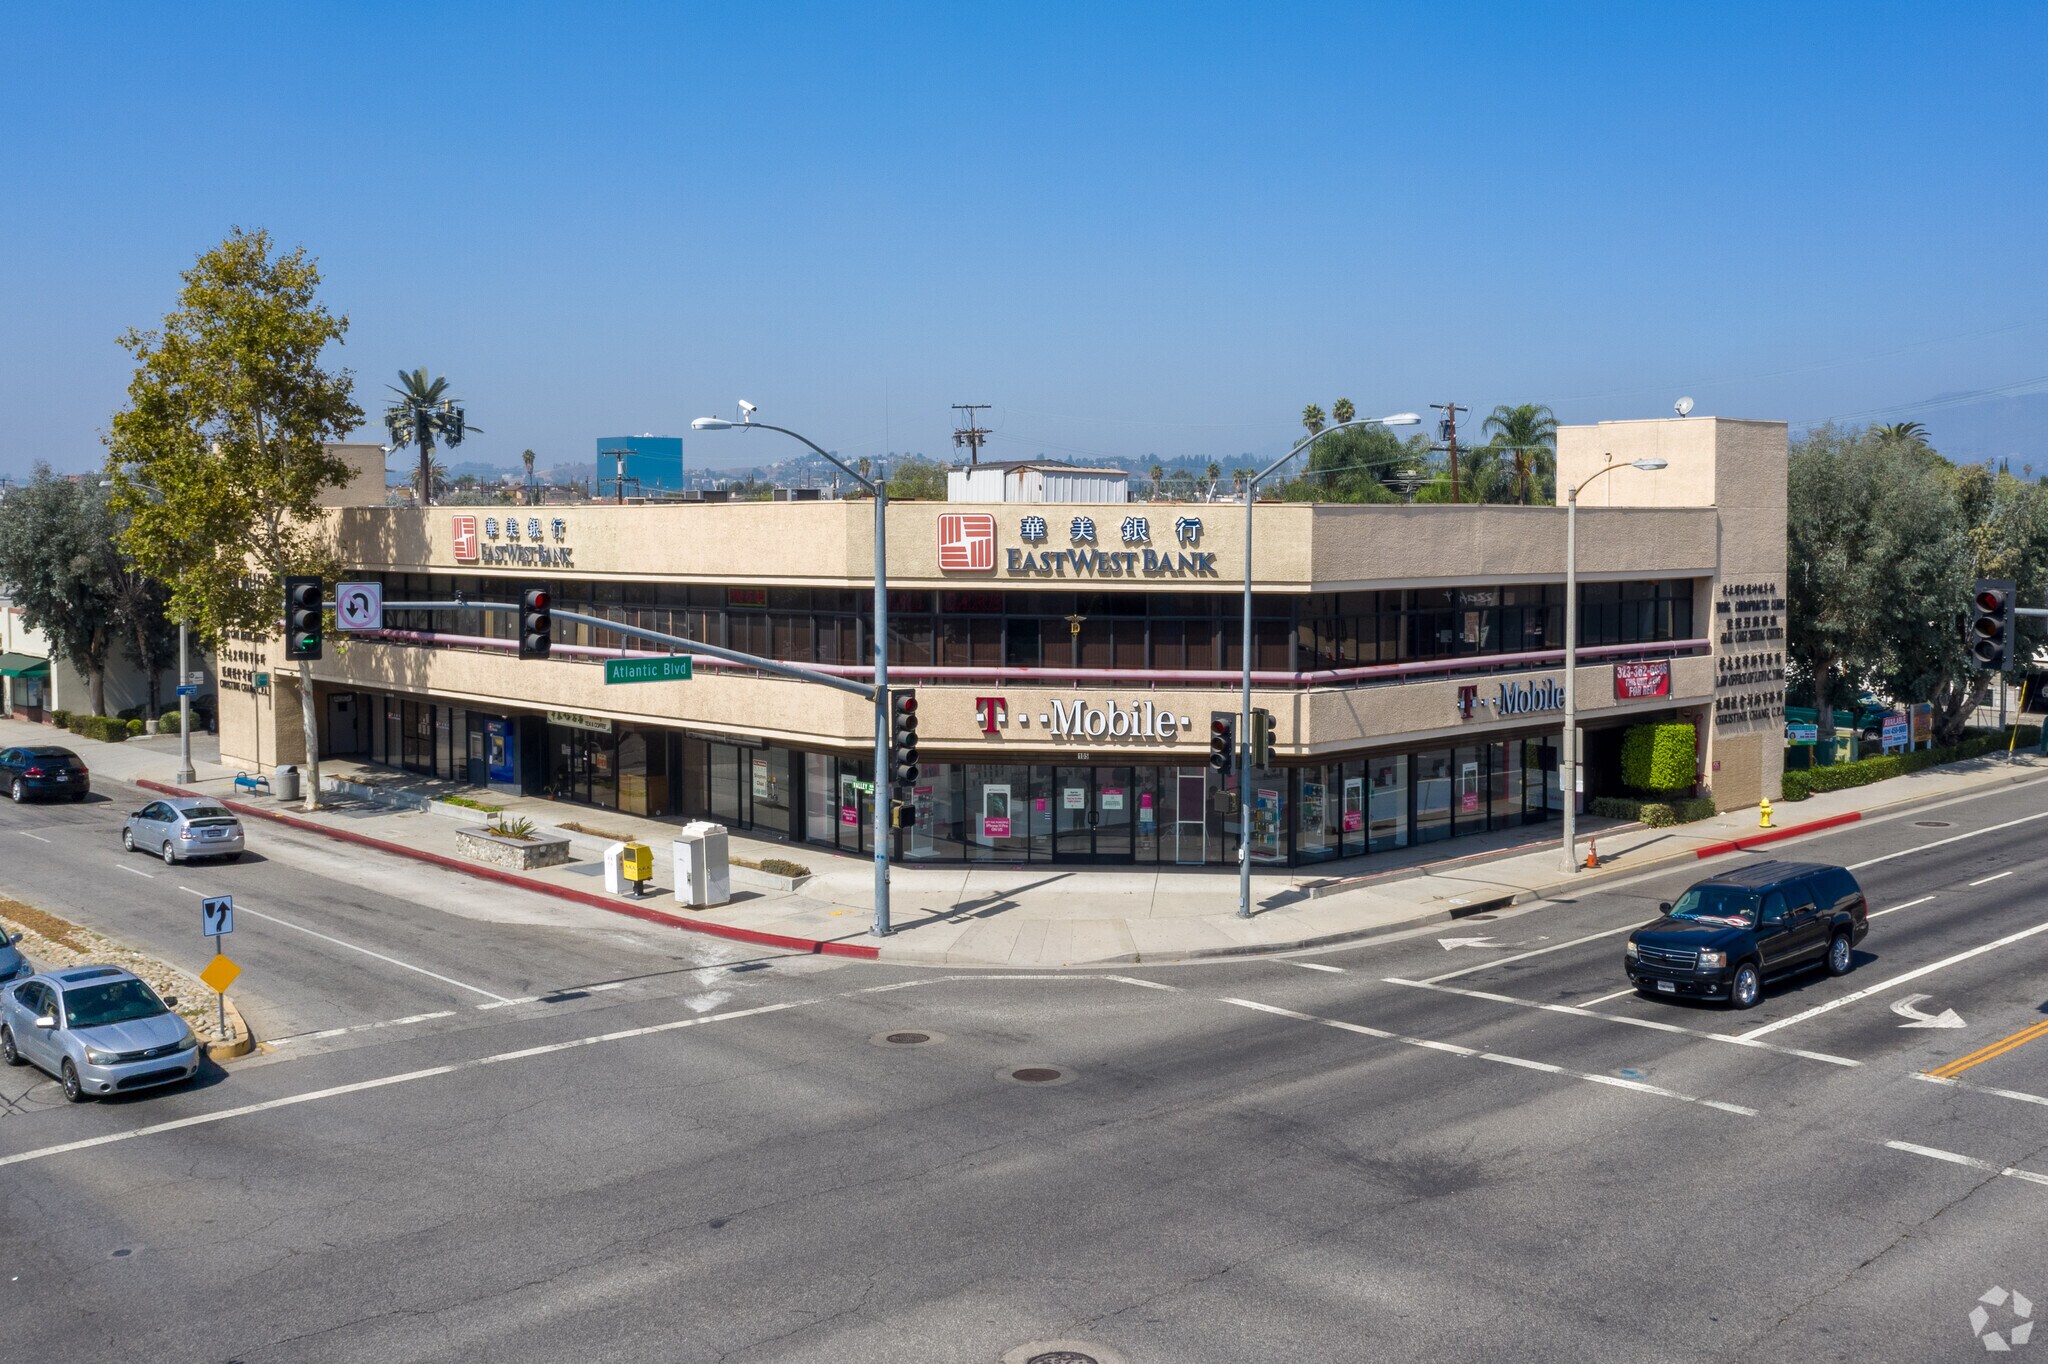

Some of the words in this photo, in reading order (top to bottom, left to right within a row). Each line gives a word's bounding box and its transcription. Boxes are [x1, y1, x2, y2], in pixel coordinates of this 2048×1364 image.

[485, 517, 564, 539] 華美銀行
[1020, 516, 1201, 542] 華美銀行
[538, 544, 573, 564] BANK
[1142, 548, 1216, 572] BANK
[613, 663, 658, 678] Atlantic
[663, 662, 686, 675] Blvd
[1500, 677, 1566, 715] Mobile
[1629, 686, 1642, 696] FOR
[1050, 698, 1176, 737] Mobile
[1716, 711, 1748, 725] CHRISTINE
[1884, 715, 1906, 727] AVAILABLE
